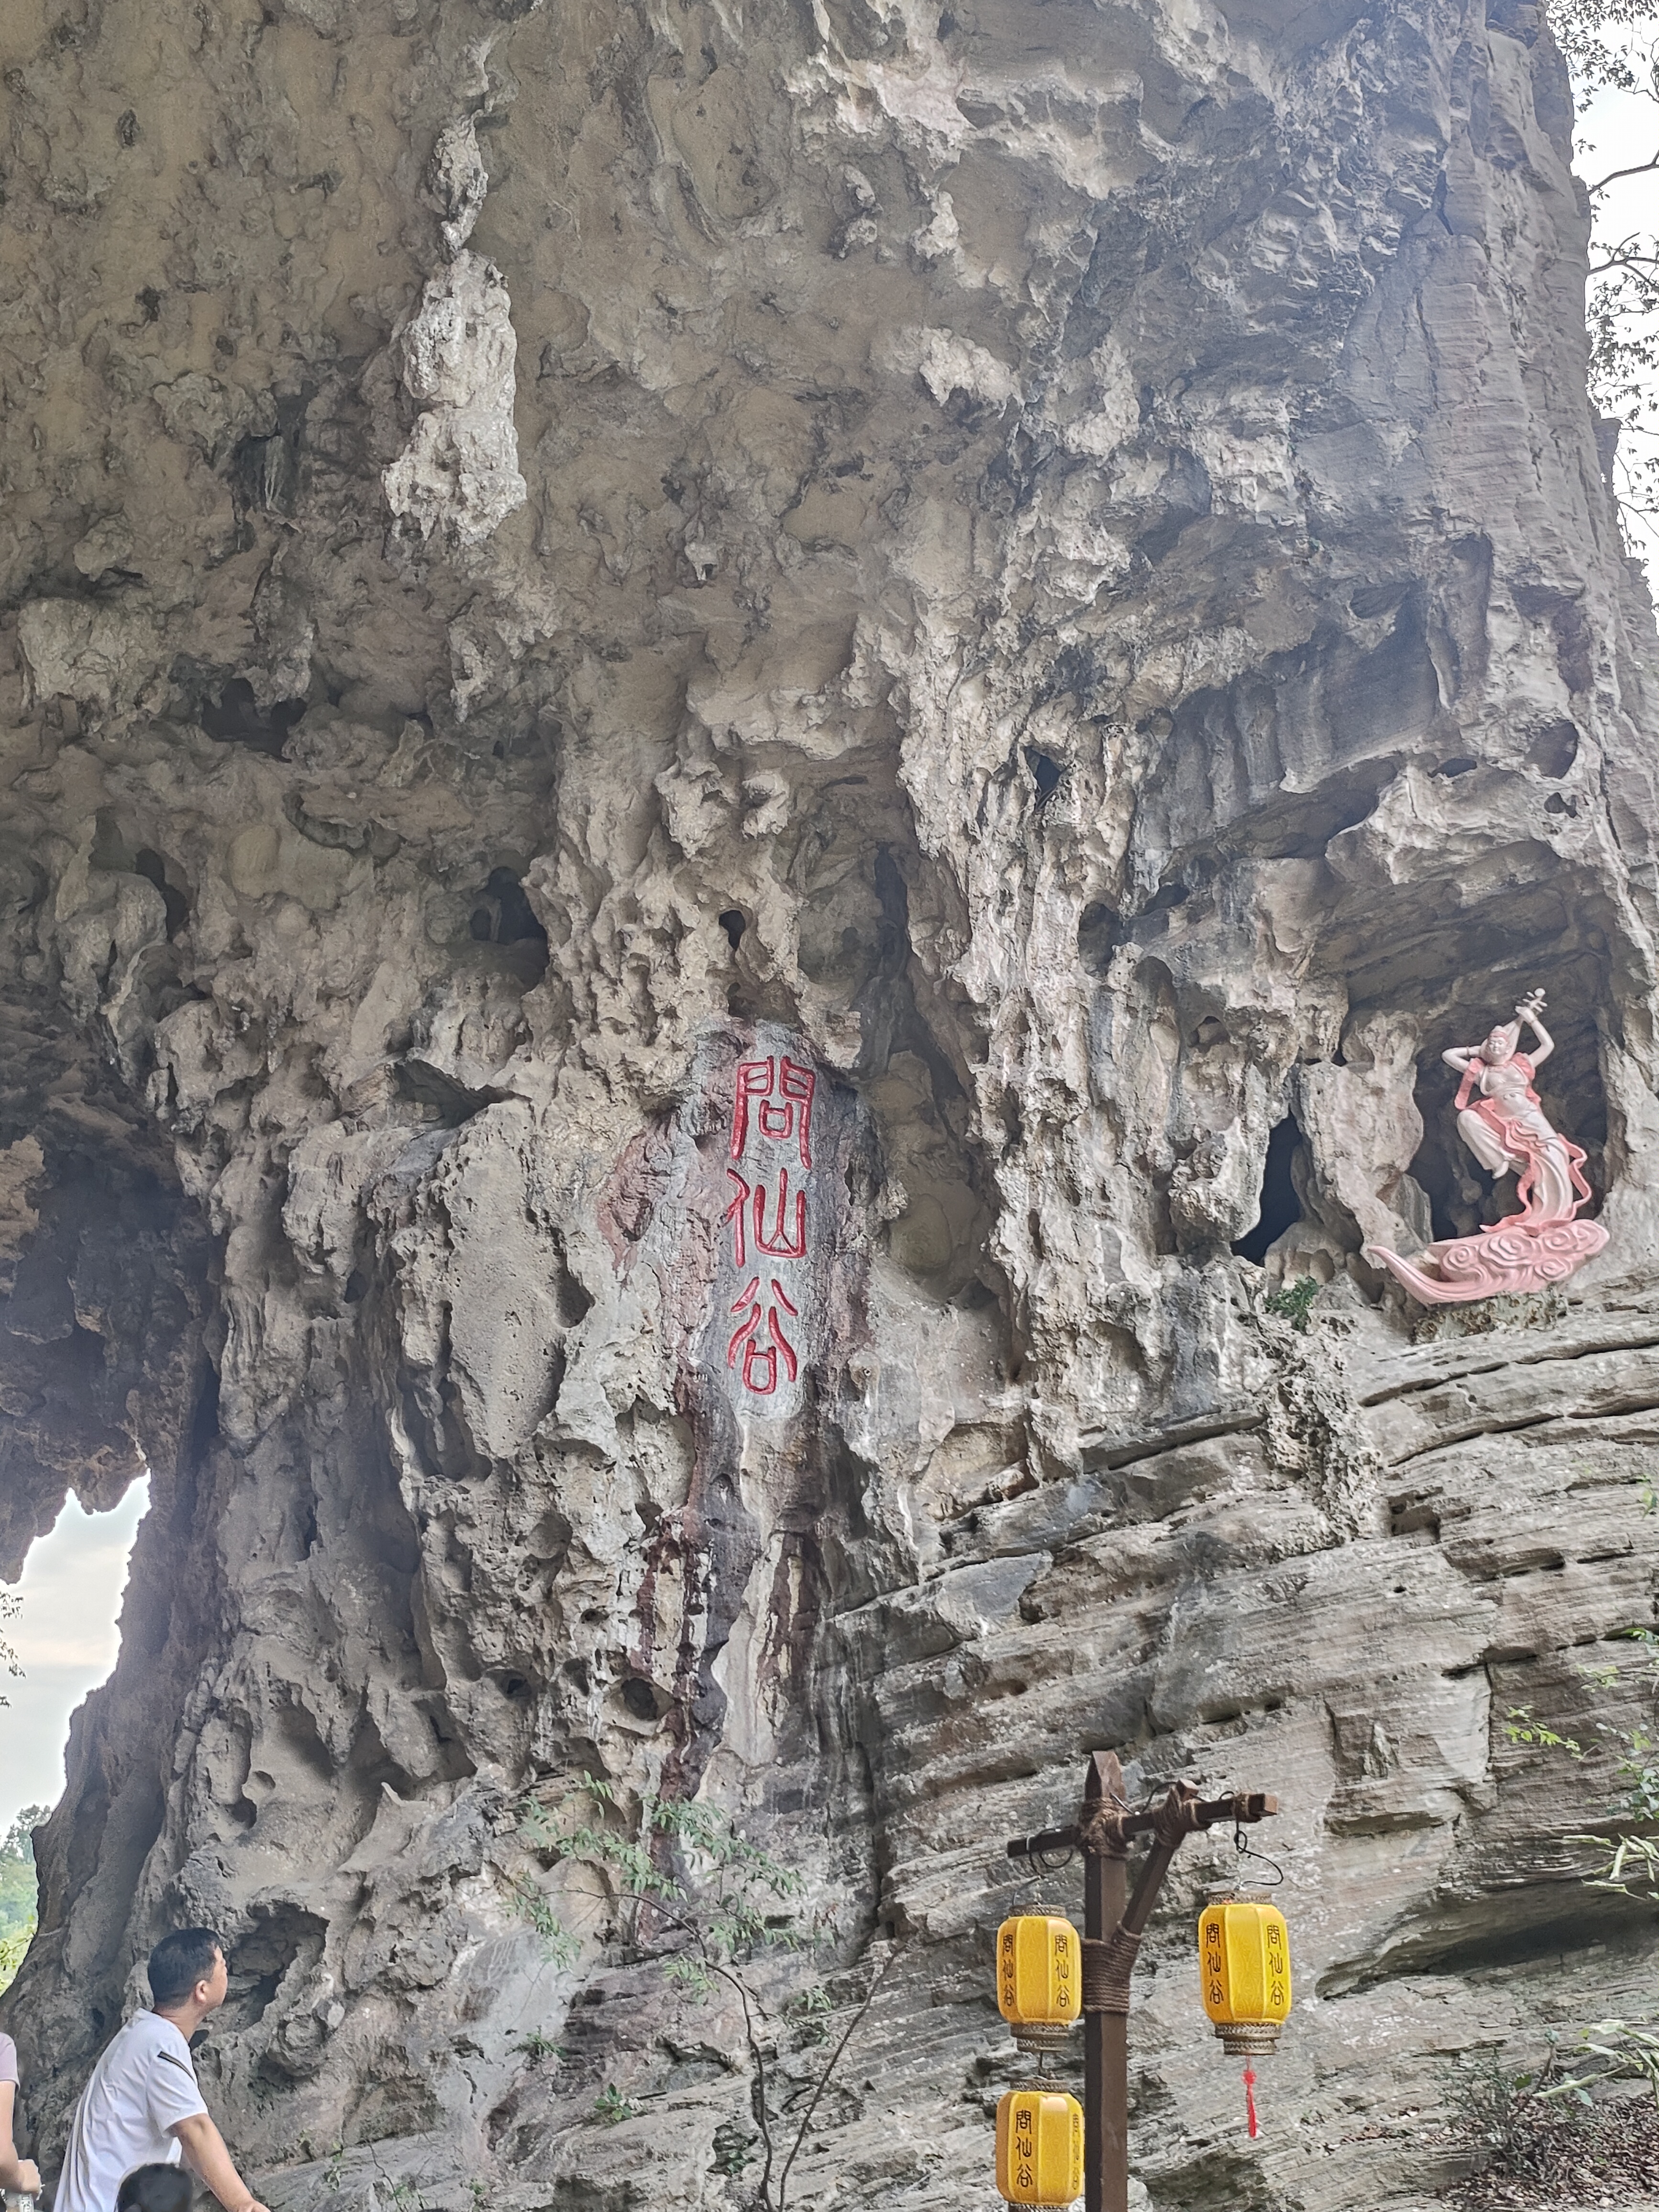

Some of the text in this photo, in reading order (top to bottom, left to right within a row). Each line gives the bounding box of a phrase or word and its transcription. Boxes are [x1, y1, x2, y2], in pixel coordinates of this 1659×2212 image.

[1055, 1935, 1070, 2007] 問仙谷
[1206, 1923, 1224, 2004] 問仙谷
[1267, 1924, 1283, 2005] 問仙谷
[1016, 2110, 1033, 2187] 問仙谷
